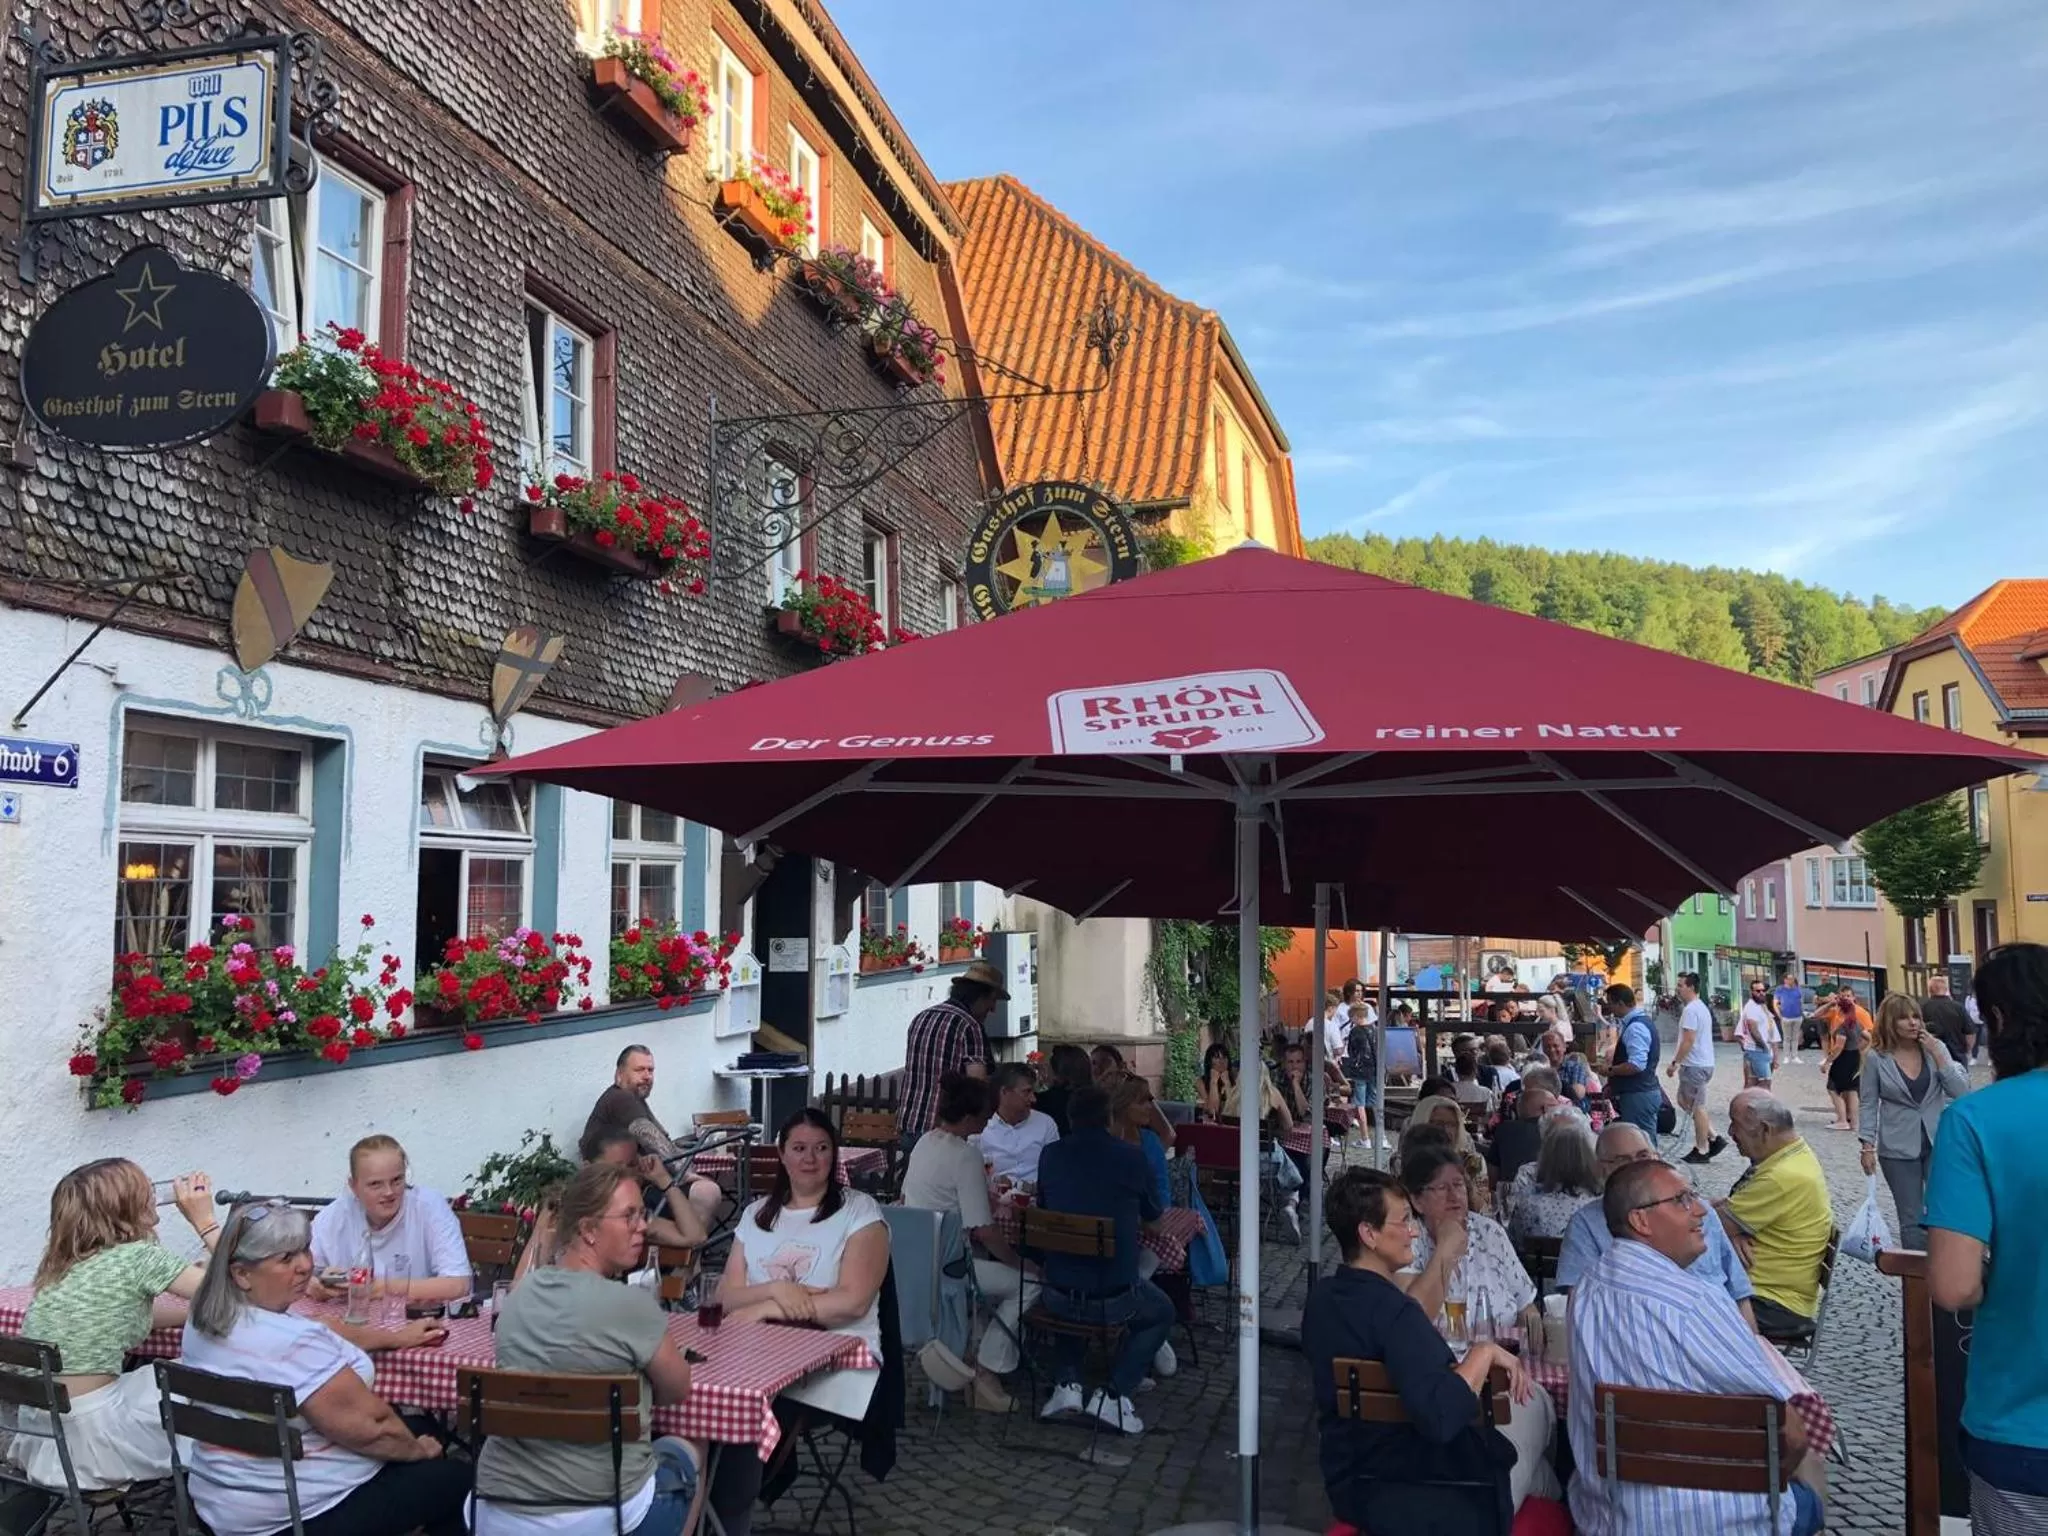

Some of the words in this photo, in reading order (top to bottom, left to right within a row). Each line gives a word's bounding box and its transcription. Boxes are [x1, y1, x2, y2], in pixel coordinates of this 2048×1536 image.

[188, 74, 222, 98] Will
[157, 96, 249, 147] PILS
[97, 336, 188, 380] Hotel
[43, 393, 125, 420] Gasthof
[129, 395, 169, 418] zum
[177, 389, 238, 410] Stern
[971, 486, 1035, 564] Gasthof
[1043, 486, 1087, 505] zum
[1091, 499, 1130, 560] Stern
[1082, 684, 1262, 718] RHÖN
[1084, 702, 1277, 733] SPRUDEL
[1376, 724, 1523, 739] reiner
[1537, 723, 1683, 737] Natur
[750, 737, 831, 751] Der
[837, 734, 995, 748] Genuss
[53, 747, 71, 777] 6
